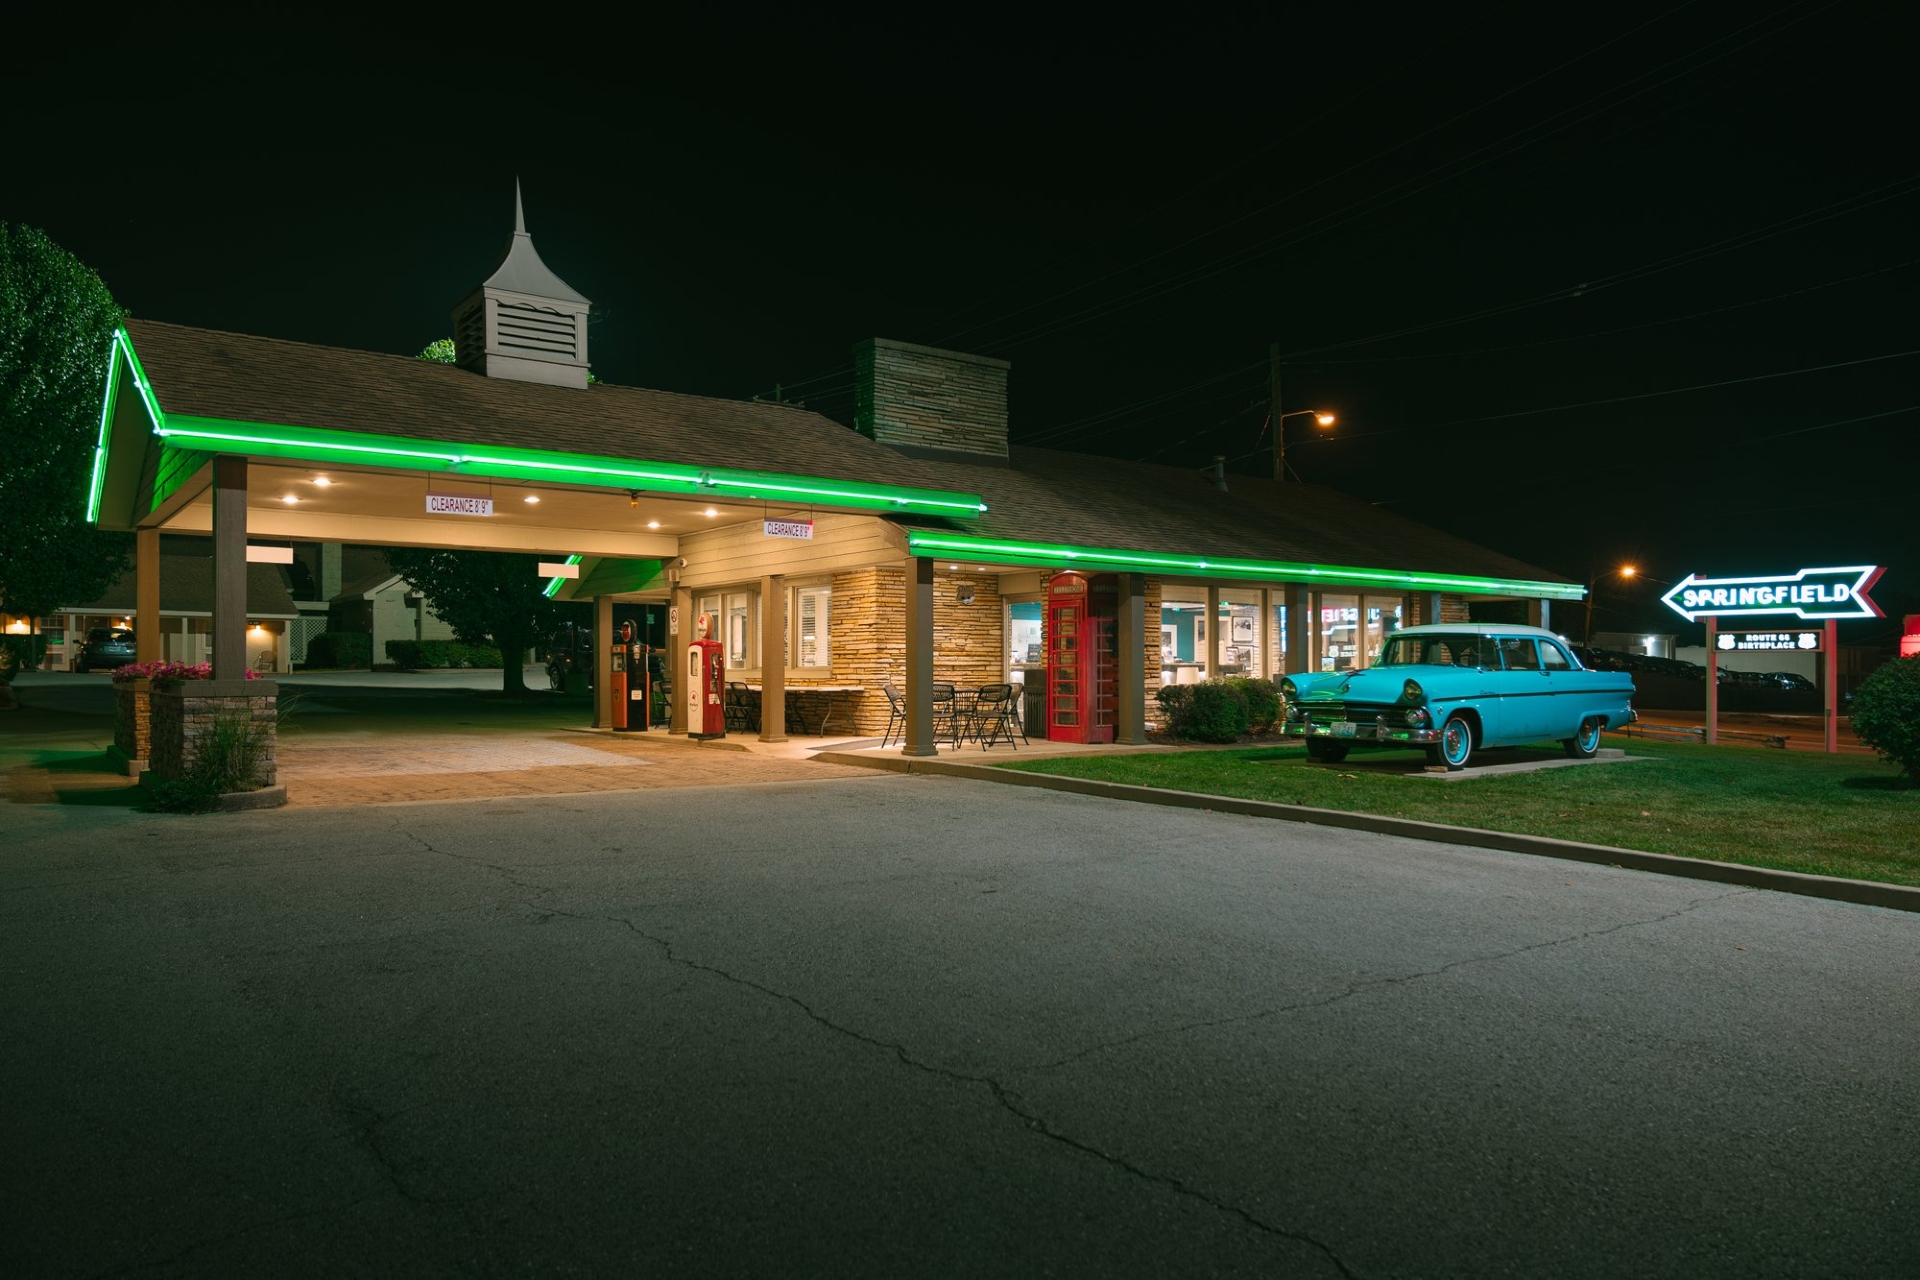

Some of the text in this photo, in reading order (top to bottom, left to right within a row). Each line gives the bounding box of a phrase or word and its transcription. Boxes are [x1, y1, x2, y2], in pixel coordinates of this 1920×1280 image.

[431, 497, 474, 513] CLEARANCE
[768, 522, 799, 537] CLEARANCE
[1683, 584, 1850, 607] SPRINGFIELD
